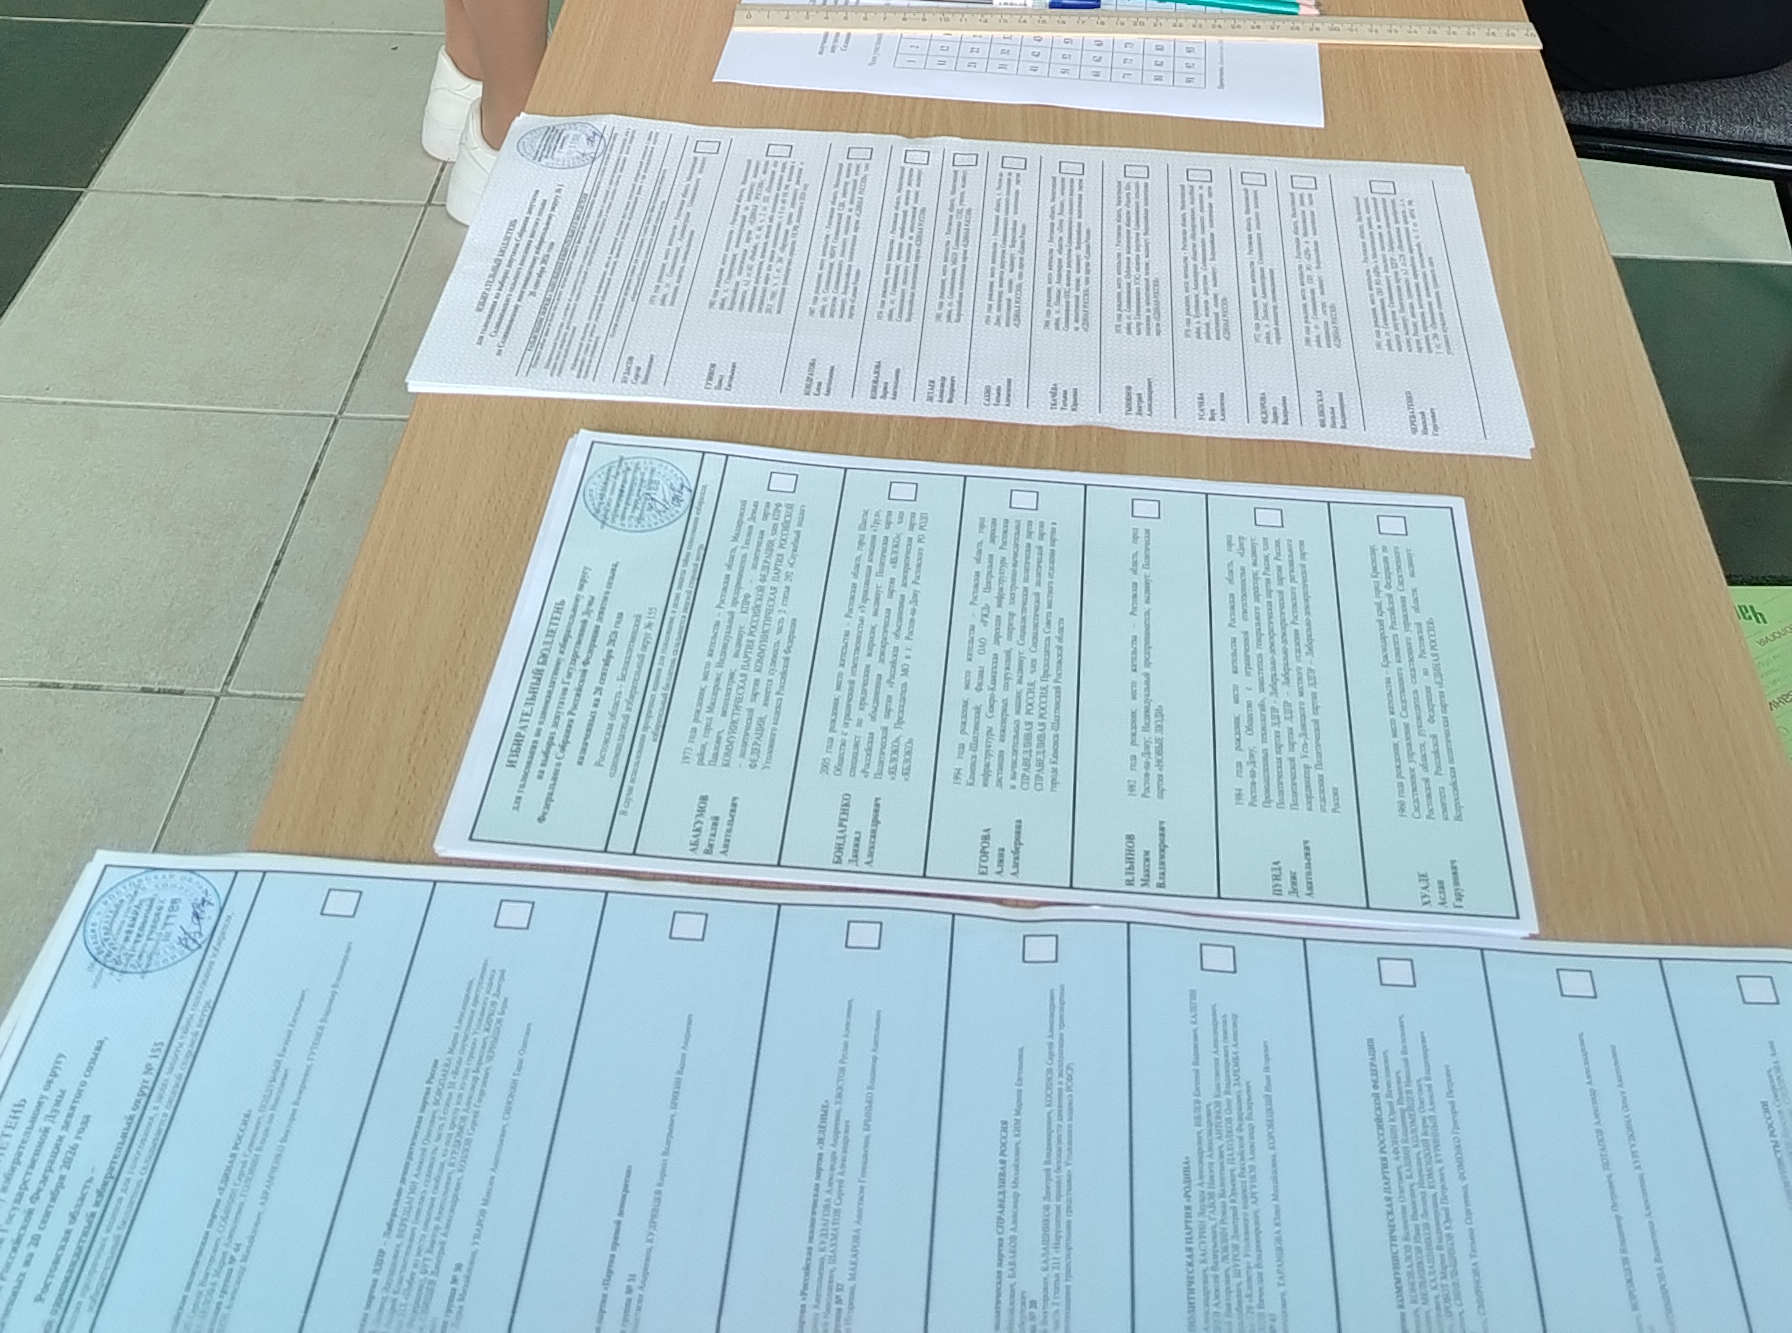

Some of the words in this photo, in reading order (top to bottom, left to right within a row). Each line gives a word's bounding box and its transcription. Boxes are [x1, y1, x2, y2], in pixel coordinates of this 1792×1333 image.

[503, 666, 546, 768] ИЗБИРАТЕЛЬНЫЙ
[535, 598, 566, 666] БЮЛЛЕТЕНЬ
[686, 794, 709, 854] АБАКУМОВ
[831, 792, 851, 865] БОНДАРЕНКО
[977, 827, 991, 876] ЕГОРОВА
[1124, 833, 1134, 886] ИЛЬИНОВ
[148, 1040, 166, 1058] 155
